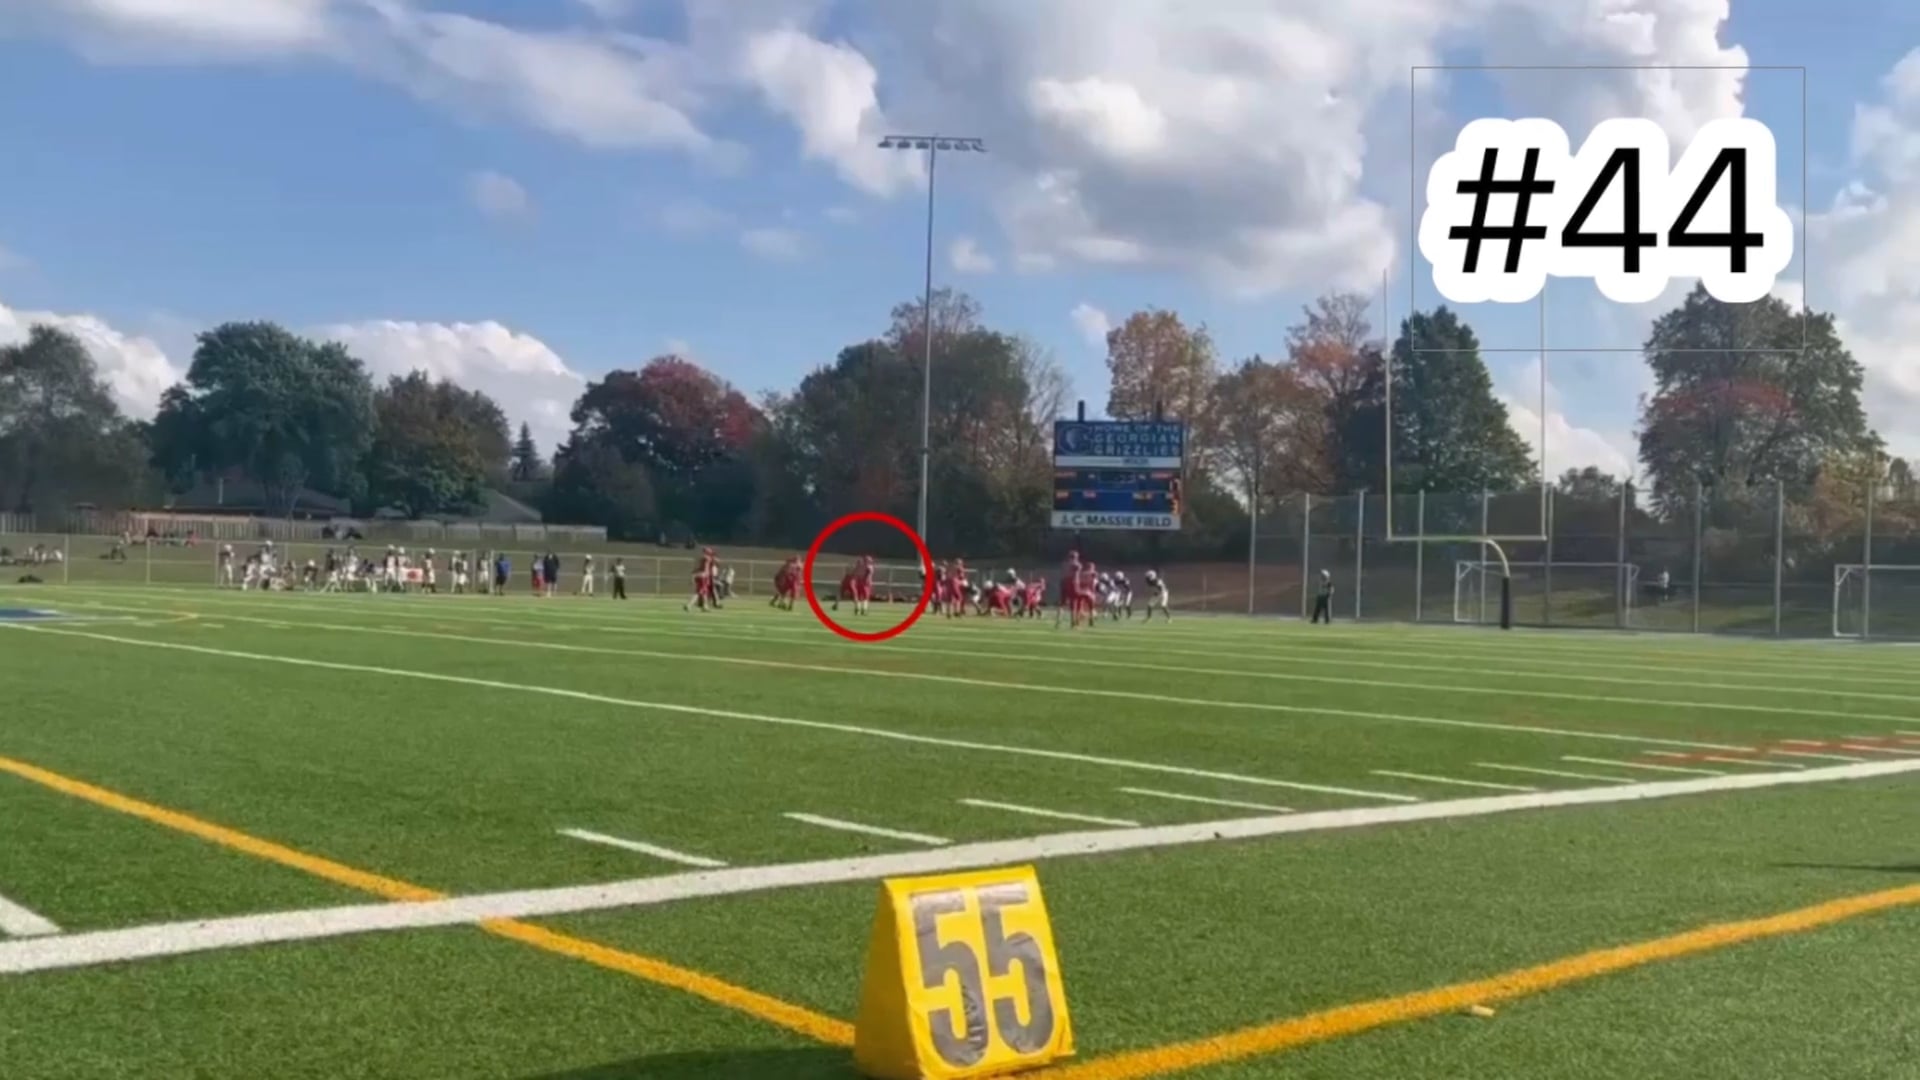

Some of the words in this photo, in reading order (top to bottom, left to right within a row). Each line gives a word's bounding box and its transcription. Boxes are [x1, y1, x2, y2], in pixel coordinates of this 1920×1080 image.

[1094, 425, 1129, 433] HOME
[1134, 425, 1150, 433] OF
[1156, 425, 1179, 433] THE
[1094, 434, 1181, 443] GEORGIAN
[1094, 445, 1181, 455] GRIZZLIES
[1087, 516, 1132, 526] MASSIE
[1137, 516, 1172, 527] FIELD
[911, 882, 1054, 1067] 55
